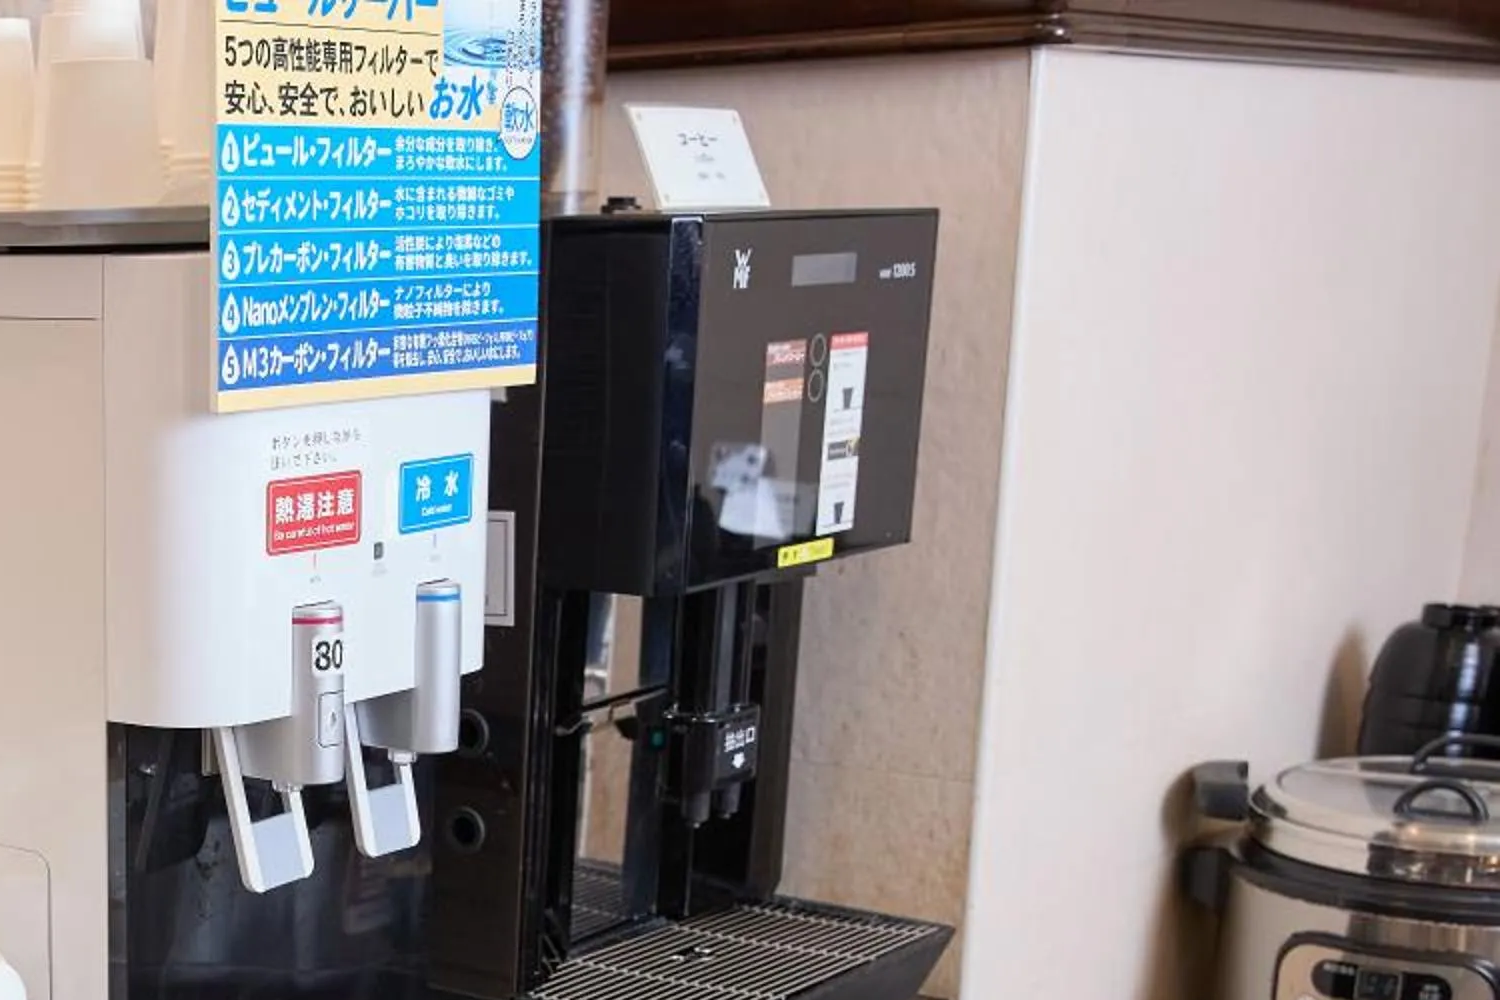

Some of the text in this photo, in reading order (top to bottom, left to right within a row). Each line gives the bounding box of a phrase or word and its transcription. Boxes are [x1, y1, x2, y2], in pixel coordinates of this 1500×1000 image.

[225, 36, 438, 76] 5つの高性能専用フィルターで
[243, 131, 392, 169] ピュール・フィルター
[242, 185, 392, 223] セディメント・フィルター
[243, 239, 392, 276] プレカーボン・フィルター
[276, 488, 354, 525] 熱湯注意
[315, 639, 343, 671] 80
